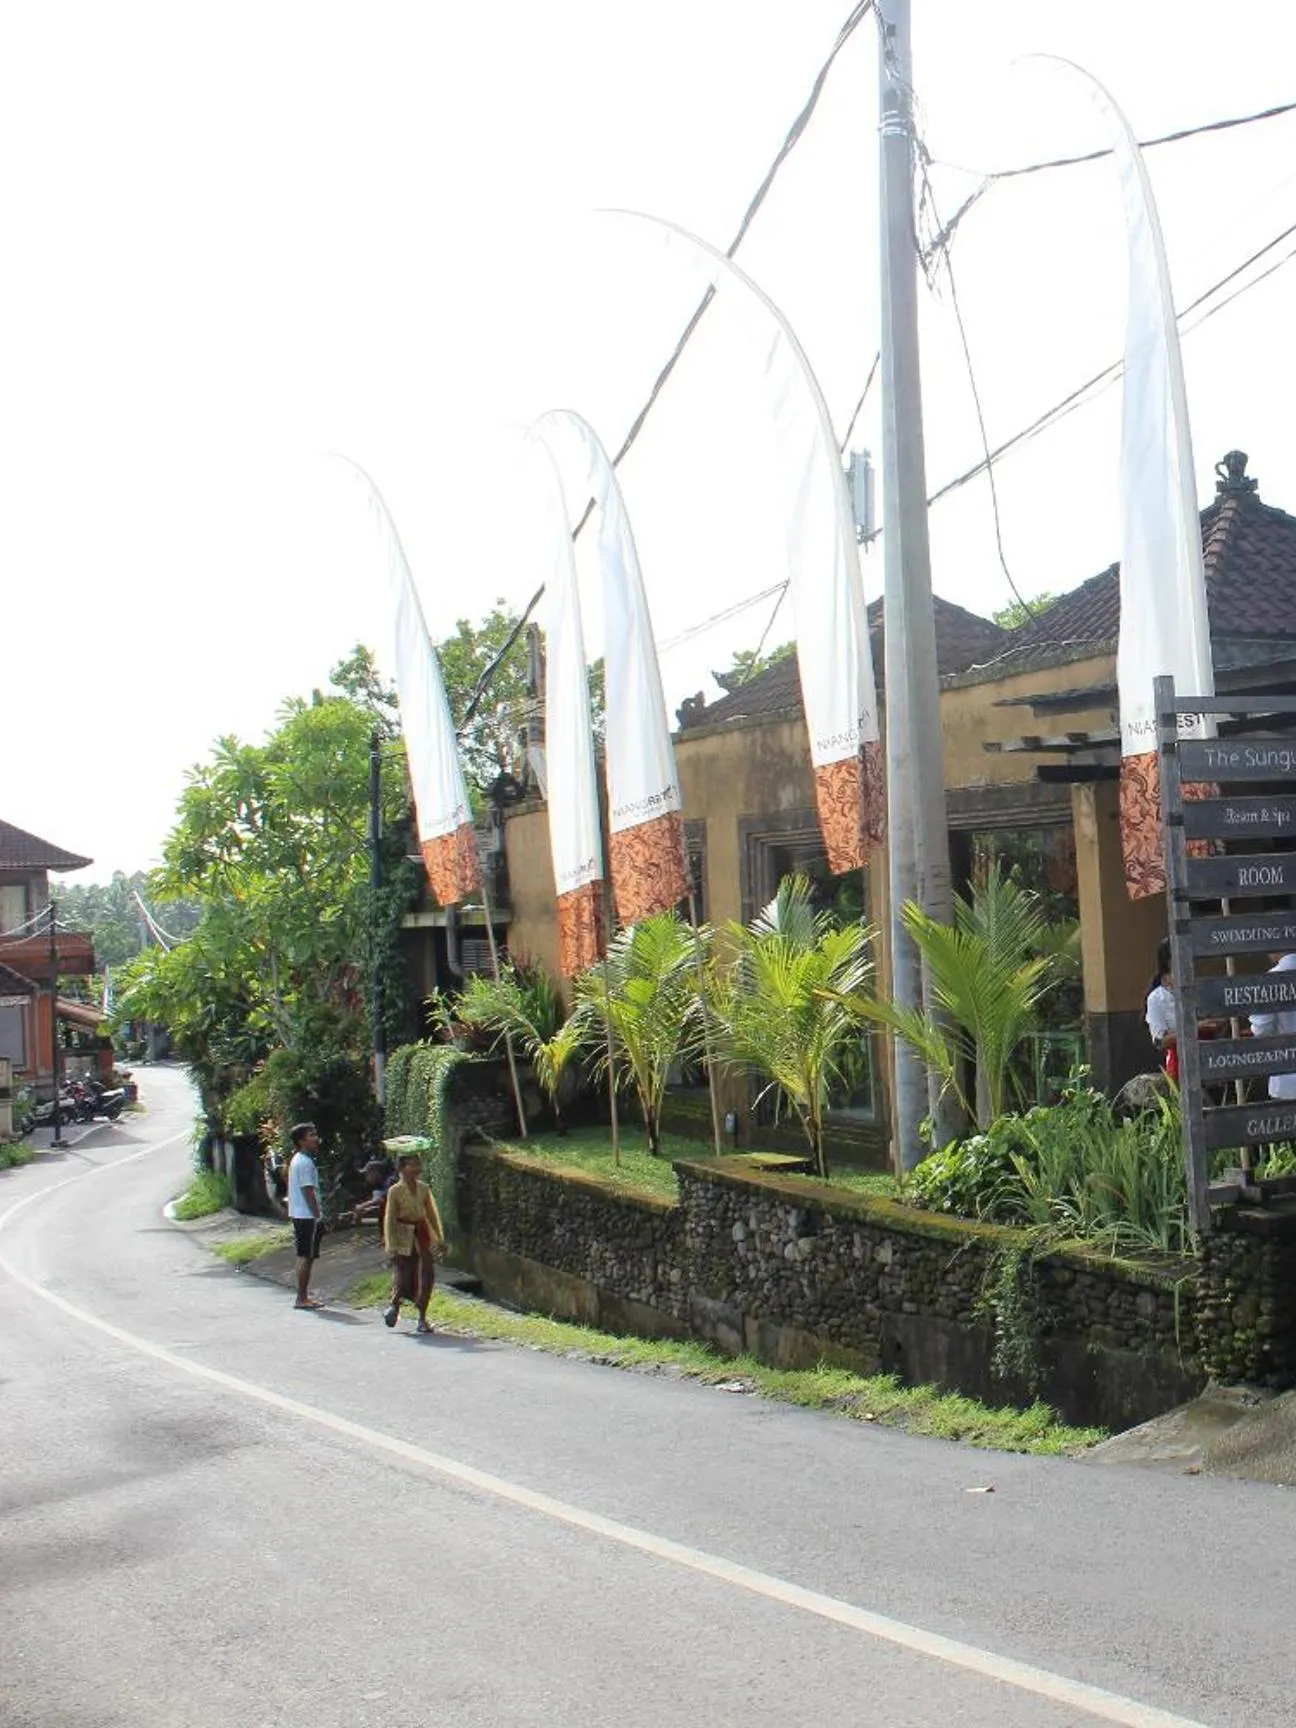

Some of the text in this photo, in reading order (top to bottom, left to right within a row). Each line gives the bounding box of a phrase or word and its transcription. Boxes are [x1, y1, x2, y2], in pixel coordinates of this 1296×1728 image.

[1203, 748, 1240, 767] The
[1238, 865, 1285, 887] ROOM
[1209, 927, 1281, 944] SWIMMING
